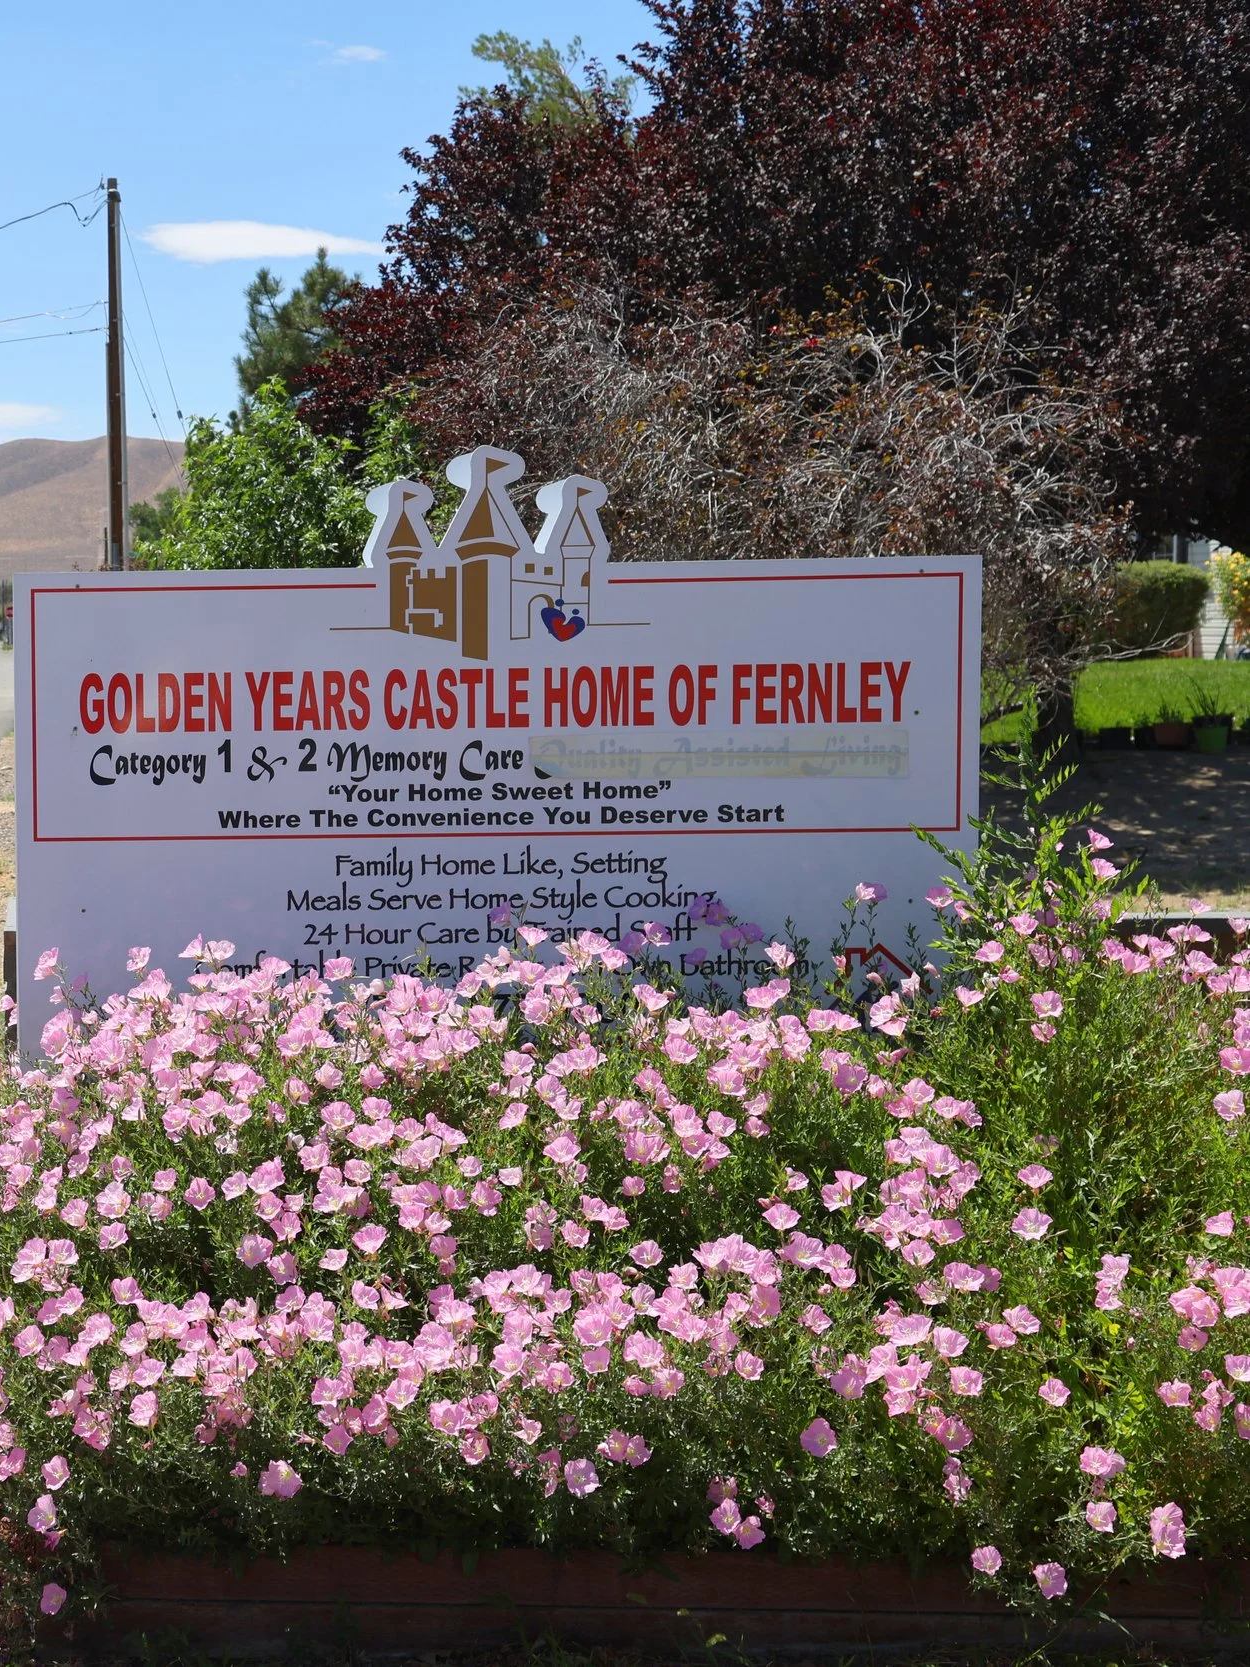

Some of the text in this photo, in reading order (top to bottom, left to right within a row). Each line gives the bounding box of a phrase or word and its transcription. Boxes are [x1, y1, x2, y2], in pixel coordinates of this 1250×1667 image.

[80, 661, 911, 734] GOLDEN YEARS CASTLE HOME OF FERNLEY
[89, 744, 206, 785] Category
[217, 739, 232, 773] 1
[246, 745, 287, 783] &
[298, 738, 317, 772] 2
[327, 741, 447, 782] Memory
[459, 739, 524, 781] Care
[328, 780, 672, 803] “Your Home Sweet Home”
[218, 803, 785, 829] Where The Convenience You Deserve Start
[335, 844, 668, 888] Family Home Like, Setting
[286, 881, 362, 912] Meals
[367, 888, 443, 911] Serve
[449, 887, 525, 910] Home
[530, 878, 598, 921] Style
[303, 923, 339, 945] 24
[344, 922, 412, 945] Hour
[417, 921, 480, 945] Care
[486, 912, 518, 950] by
[630, 911, 698, 941] Sff
